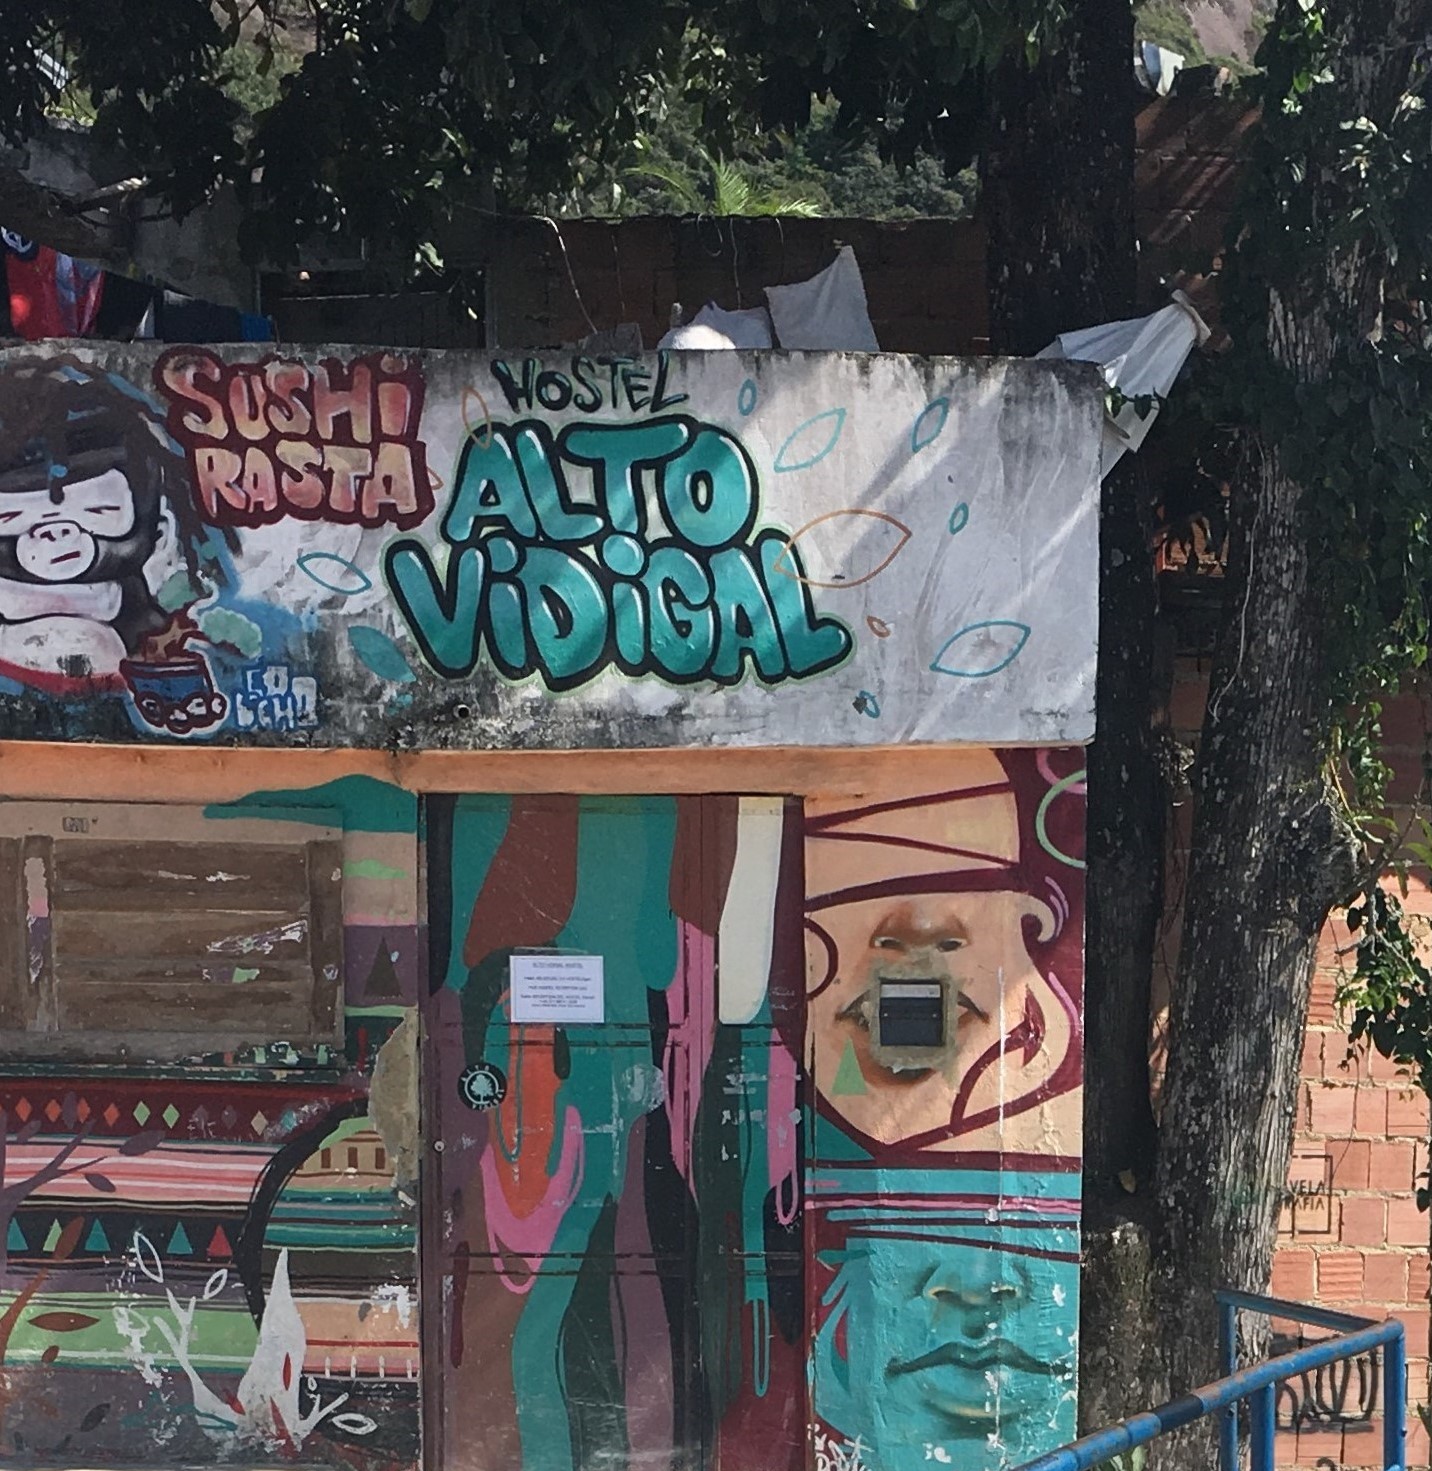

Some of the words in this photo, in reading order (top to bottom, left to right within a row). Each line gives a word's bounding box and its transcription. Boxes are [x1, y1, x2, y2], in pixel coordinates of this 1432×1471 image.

[491, 351, 688, 413] HOSTEL
[192, 438, 432, 527] RASTA
[441, 415, 760, 547] ALTO
